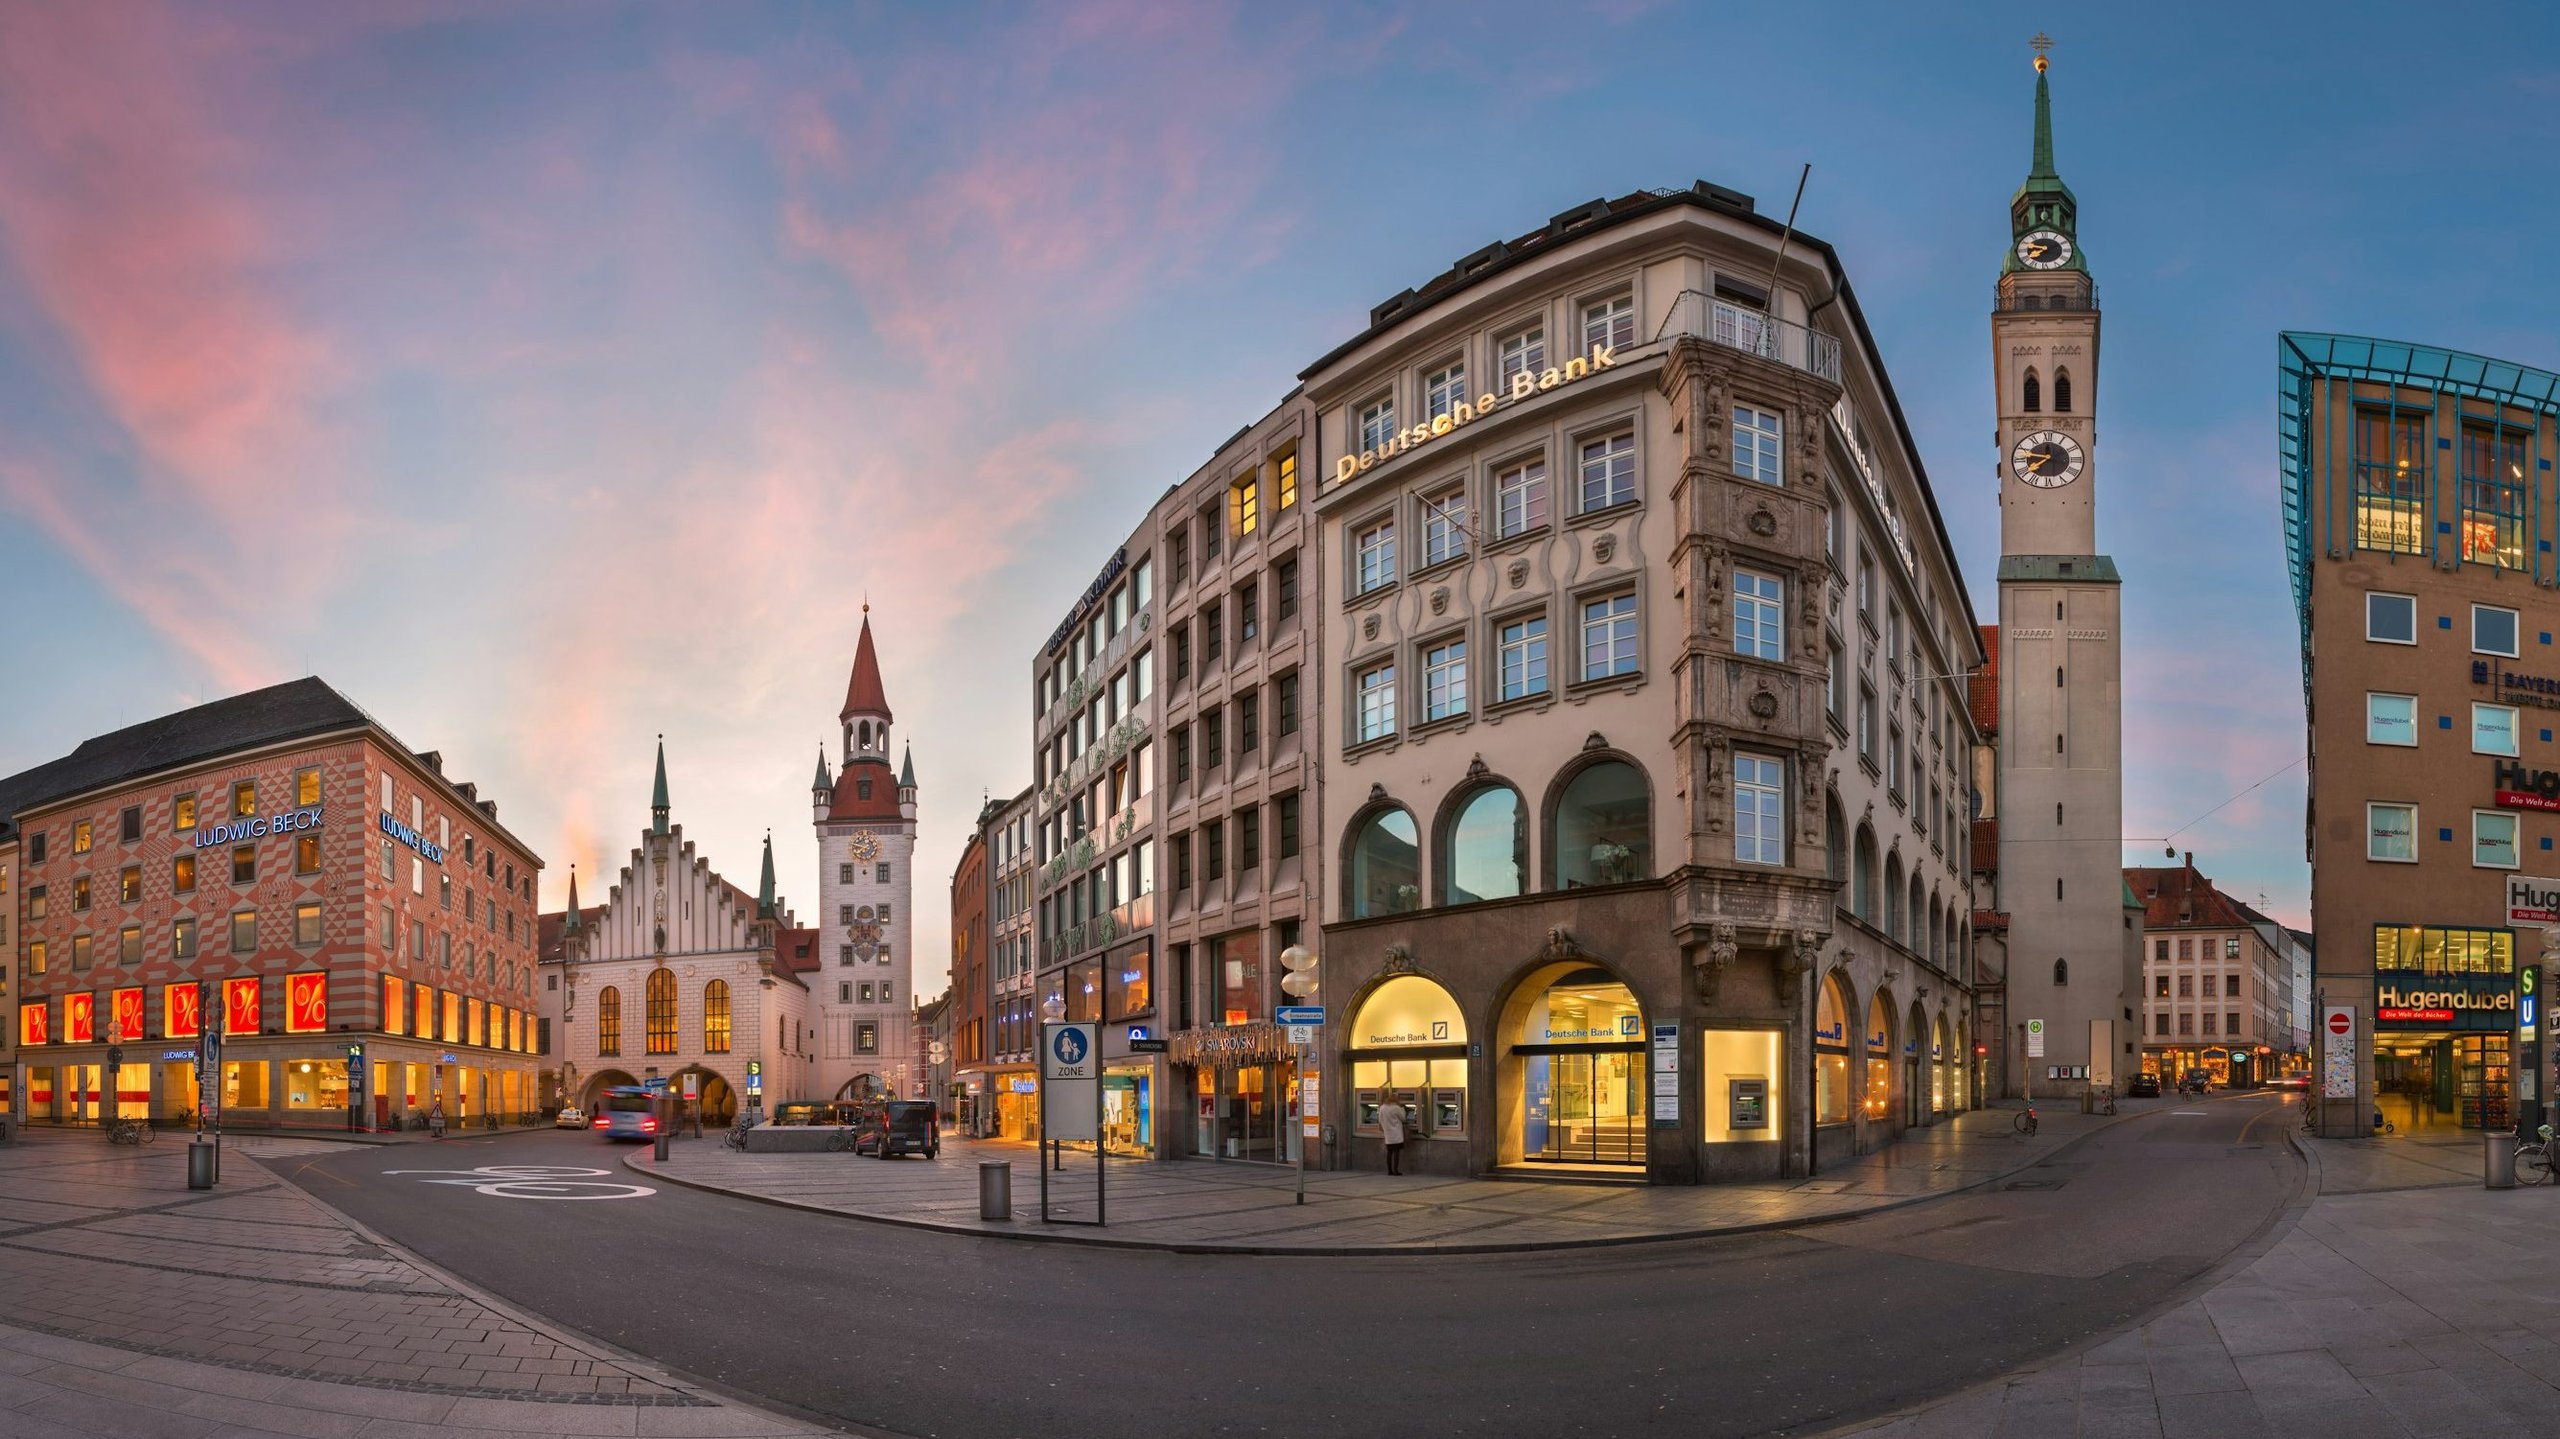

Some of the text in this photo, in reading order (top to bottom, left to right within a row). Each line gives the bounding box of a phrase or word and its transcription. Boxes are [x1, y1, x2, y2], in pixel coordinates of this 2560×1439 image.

[1337, 343, 1616, 485] Deutsche Bank
[1837, 400, 1914, 578] Deutsche Bank
[2374, 716, 2409, 724] Hugendubel
[2477, 722, 2512, 732] Hugendubel
[2510, 796, 2558, 809] Die Welt der
[195, 808, 325, 849] LUDWIG BECK
[2374, 828, 2409, 836] Hugendubel
[381, 812, 443, 865] LUDWIG BECK
[2478, 836, 2512, 846] Hugendubel
[2517, 910, 2529, 918] Die
[2530, 912, 2546, 920] Welt
[2523, 969, 2533, 993] S
[2378, 985, 2515, 1012] Hugendubel
[2398, 1011, 2413, 1019] Welt
[2523, 999, 2533, 1023] U
[1370, 1033, 1428, 1044] Deutsche Bank
[1545, 1027, 1614, 1039] Deutsche Bank
[1206, 1036, 1256, 1051] SWAROVSKI
[163, 1051, 188, 1059] LUDWIG
[1058, 1066, 1084, 1077] ZONE
